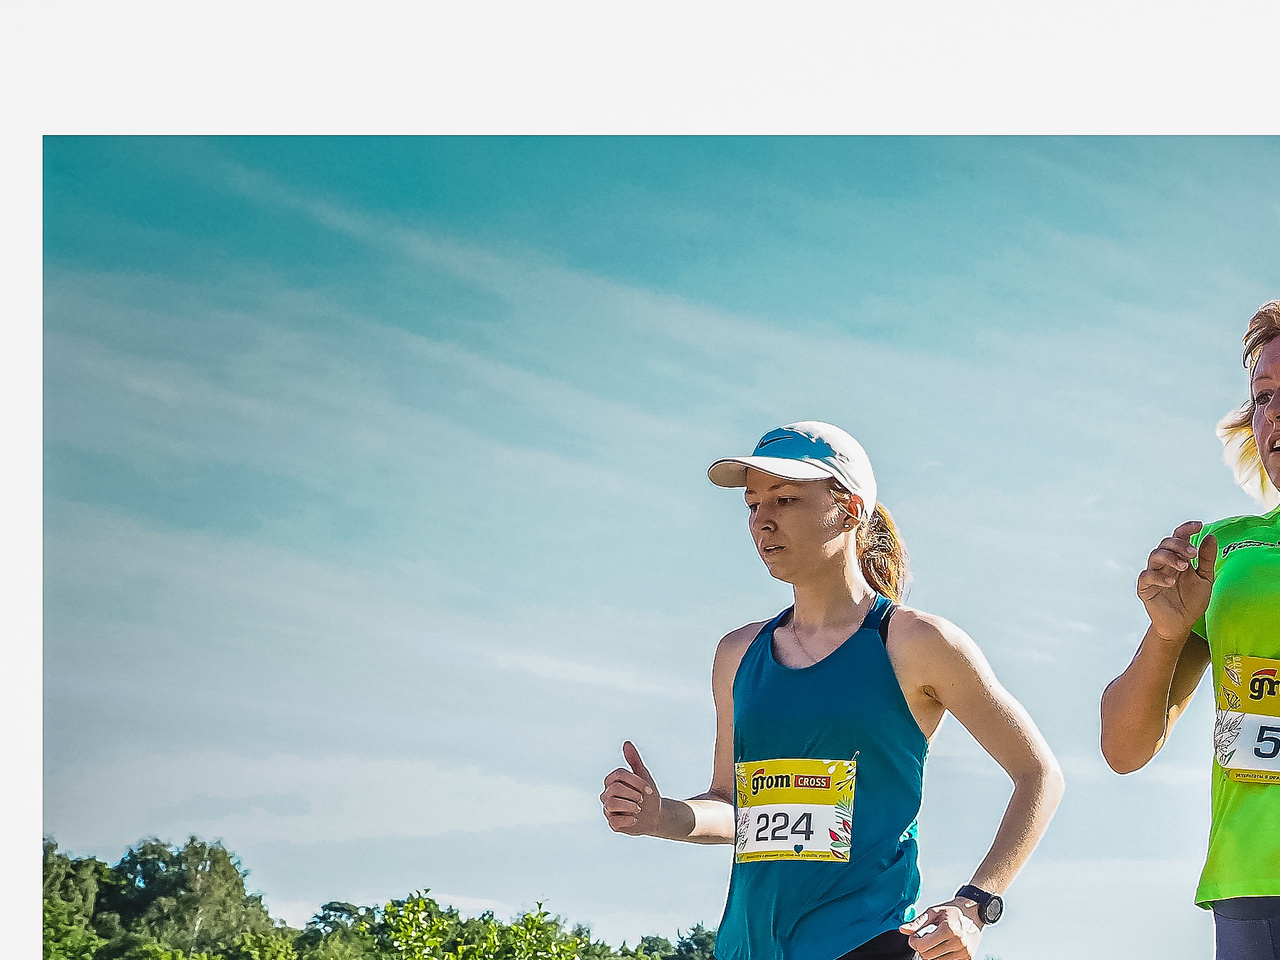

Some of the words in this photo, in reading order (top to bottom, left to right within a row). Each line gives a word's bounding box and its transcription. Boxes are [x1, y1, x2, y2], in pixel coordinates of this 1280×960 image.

[752, 772, 791, 795] grom
[797, 777, 828, 787] CROSS
[755, 812, 815, 841] 224
